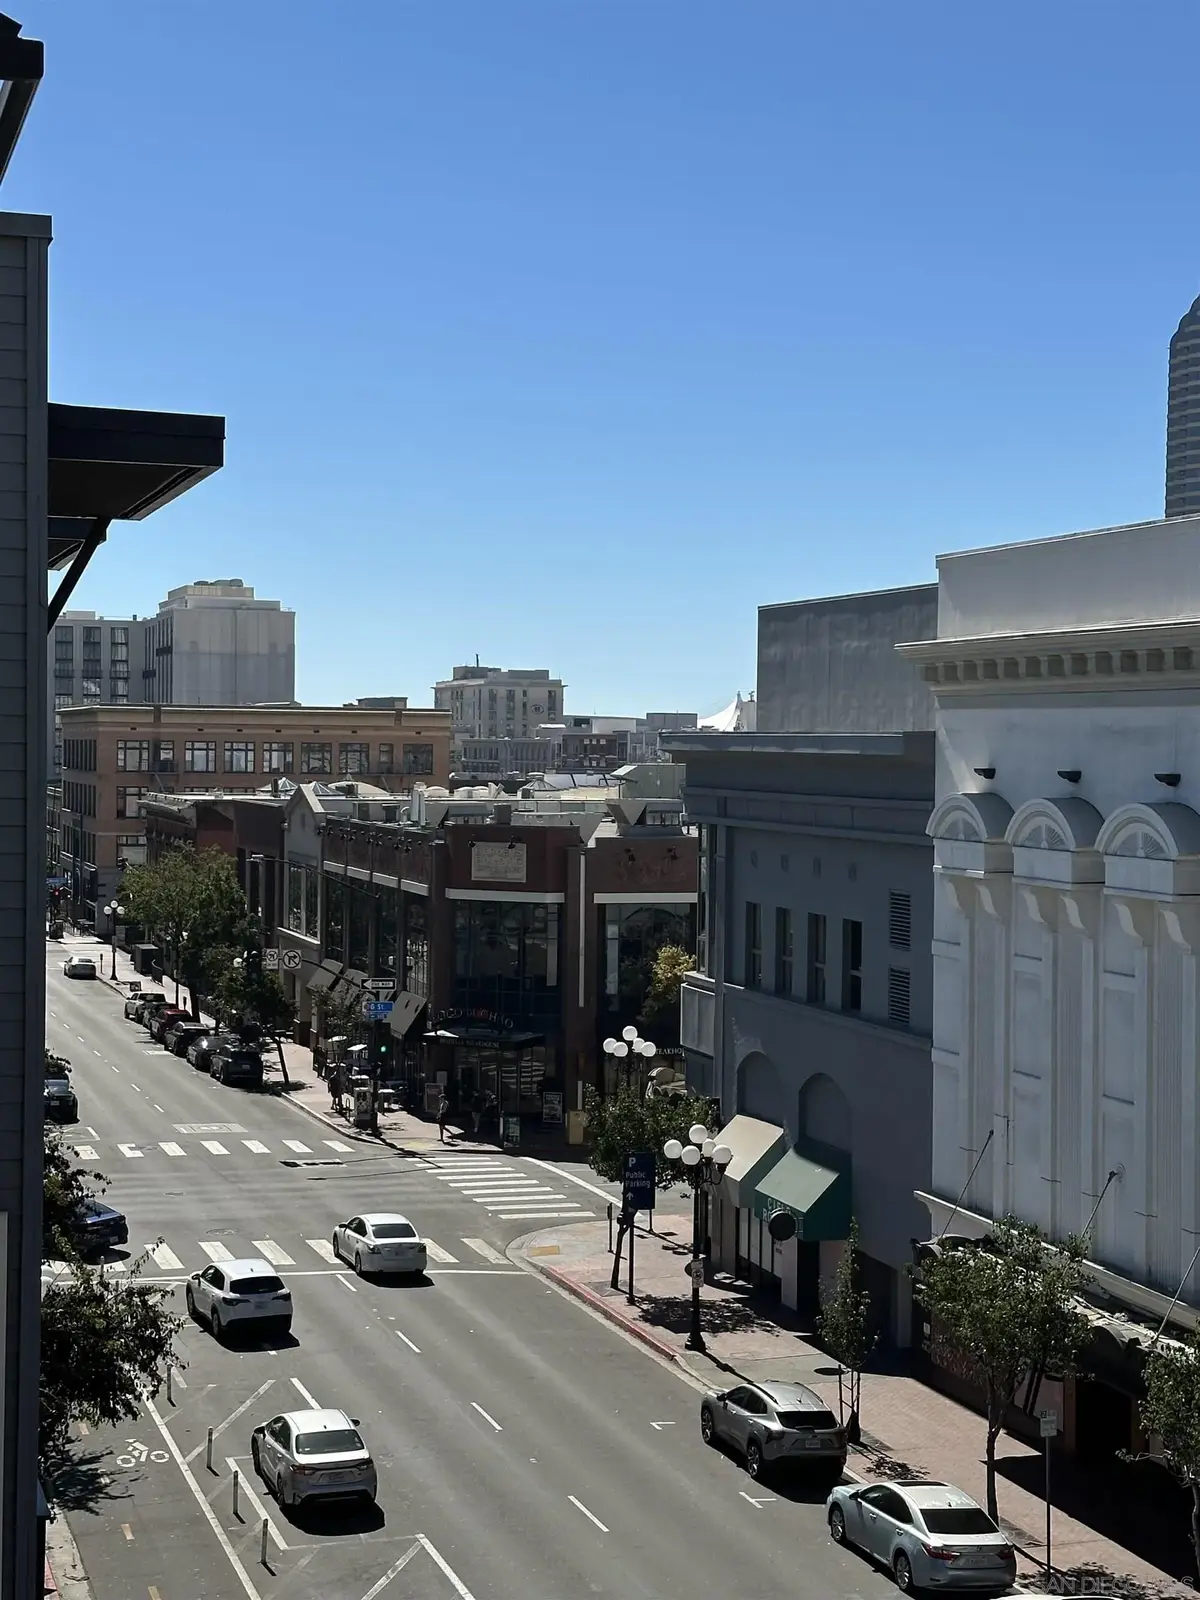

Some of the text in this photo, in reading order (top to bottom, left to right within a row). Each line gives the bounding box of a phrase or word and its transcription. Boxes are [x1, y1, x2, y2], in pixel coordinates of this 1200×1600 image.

[370, 1003, 376, 1011] G
[628, 1156, 636, 1168] P
[625, 1171, 646, 1179] Public
[625, 1180, 651, 1189] Parking
